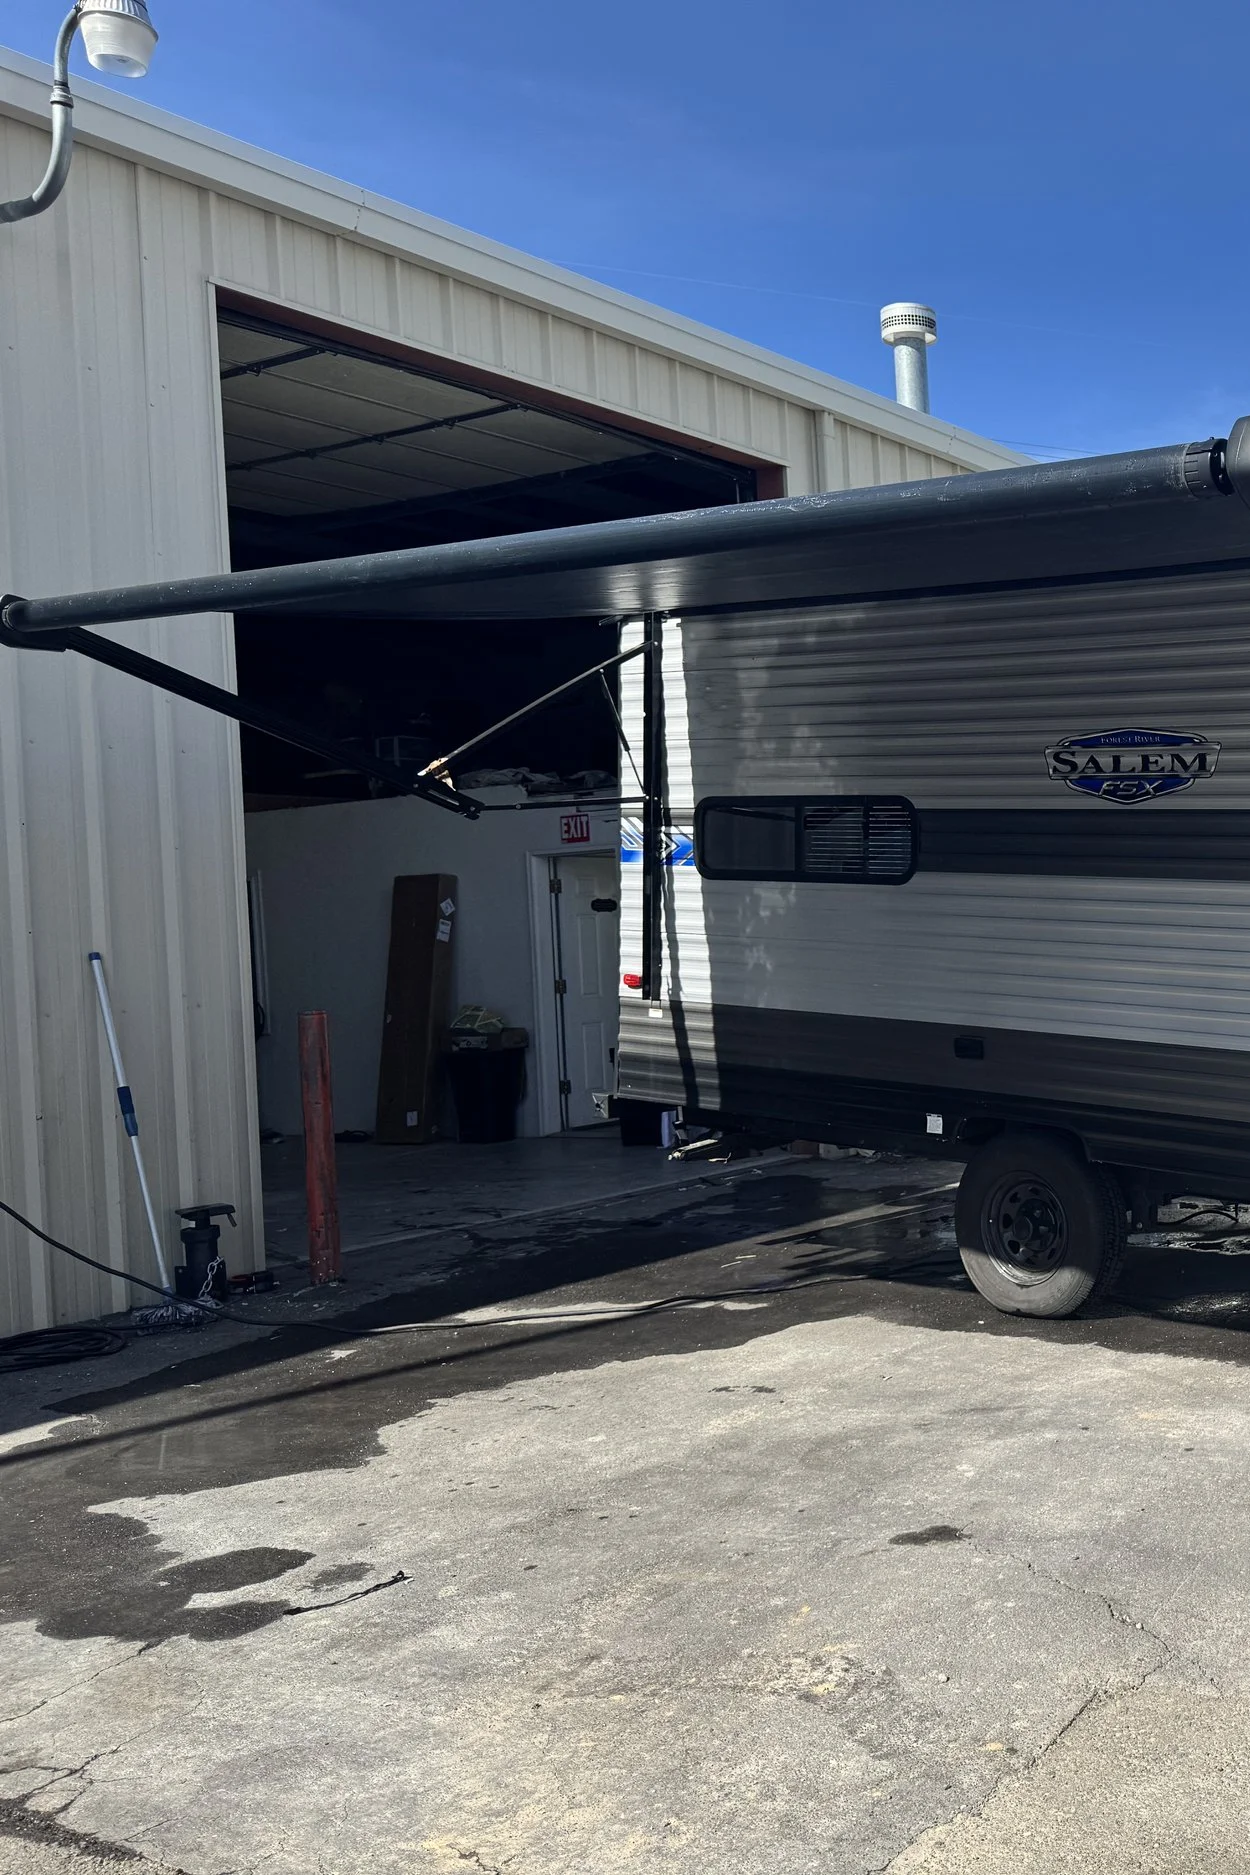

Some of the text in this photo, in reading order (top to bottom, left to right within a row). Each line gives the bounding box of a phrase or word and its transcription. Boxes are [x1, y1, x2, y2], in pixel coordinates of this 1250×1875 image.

[1134, 735, 1161, 743] RIVER
[1052, 750, 1211, 774] SALEM
[1098, 780, 1163, 796] FSX
[561, 816, 588, 839] EXIT
